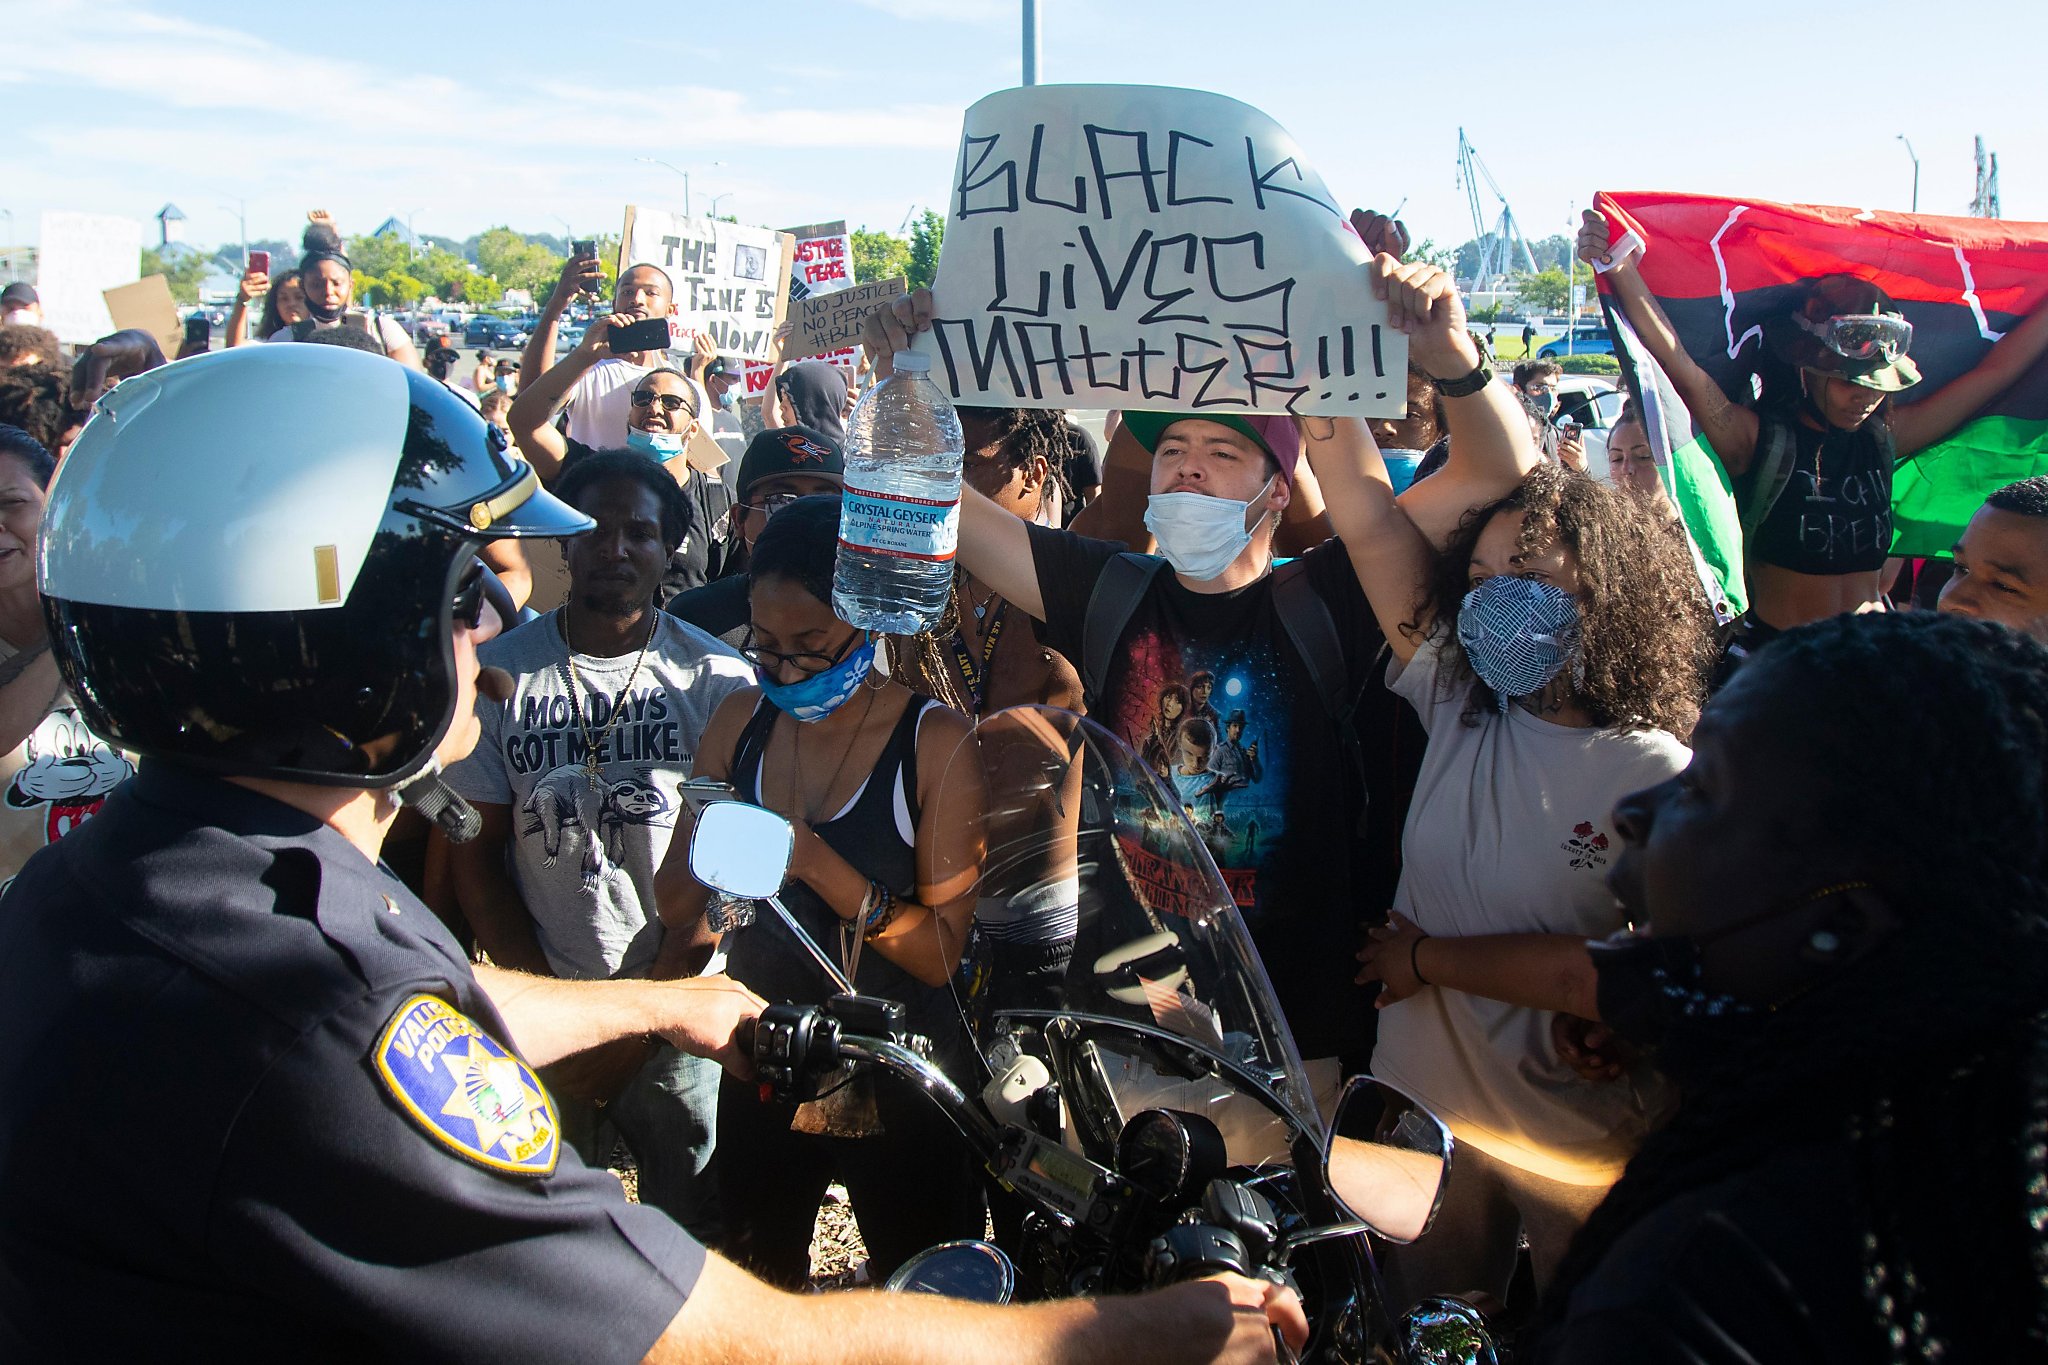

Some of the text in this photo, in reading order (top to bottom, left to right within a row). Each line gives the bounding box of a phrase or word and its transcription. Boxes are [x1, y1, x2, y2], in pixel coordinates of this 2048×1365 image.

[957, 124, 1340, 219] BLACK
[662, 235, 717, 274] THE
[794, 238, 844, 263] USTICE
[805, 260, 846, 284] PEACE
[755, 290, 775, 318] IS
[803, 283, 900, 318] NO JUSTICE
[709, 321, 770, 358] NOW!
[803, 317, 826, 335] NO
[854, 489, 881, 498] BOTTLED
[1797, 469, 1836, 502] I
[848, 501, 938, 524] CRYSTAL GEYSER
[868, 516, 917, 529] NATURAL
[850, 518, 932, 538] ALPINE SPRING WATER
[984, 635, 996, 661] NAVY
[957, 653, 973, 677] NAVY
[524, 686, 669, 732] MONDAYS
[506, 731, 564, 776] GOT
[615, 721, 695, 764] LIKE...
[417, 1019, 484, 1073] POLICE
